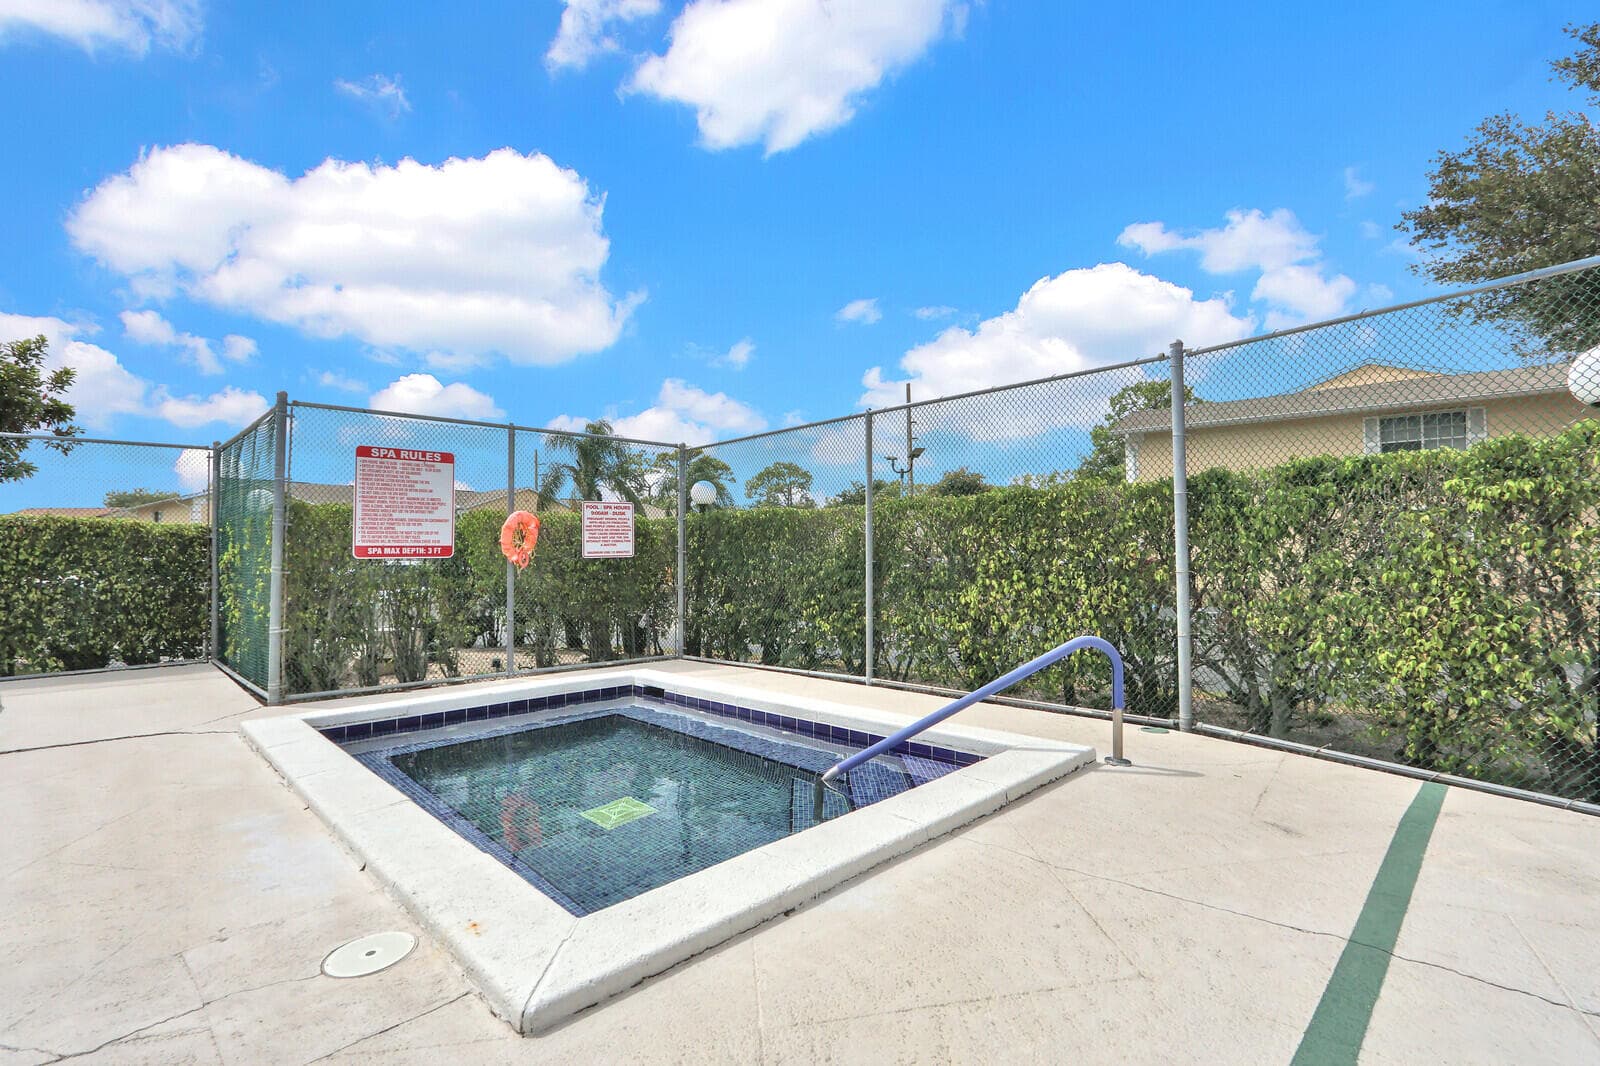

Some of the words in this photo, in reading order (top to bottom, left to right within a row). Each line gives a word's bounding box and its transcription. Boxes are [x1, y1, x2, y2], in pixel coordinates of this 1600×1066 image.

[371, 448, 396, 458] SPA
[400, 450, 441, 461] RULES
[367, 547, 382, 555] SPA
[384, 547, 400, 555] MAX
[402, 547, 426, 555] DEPTH:
[427, 547, 433, 555] 3
[434, 547, 441, 555] FT
